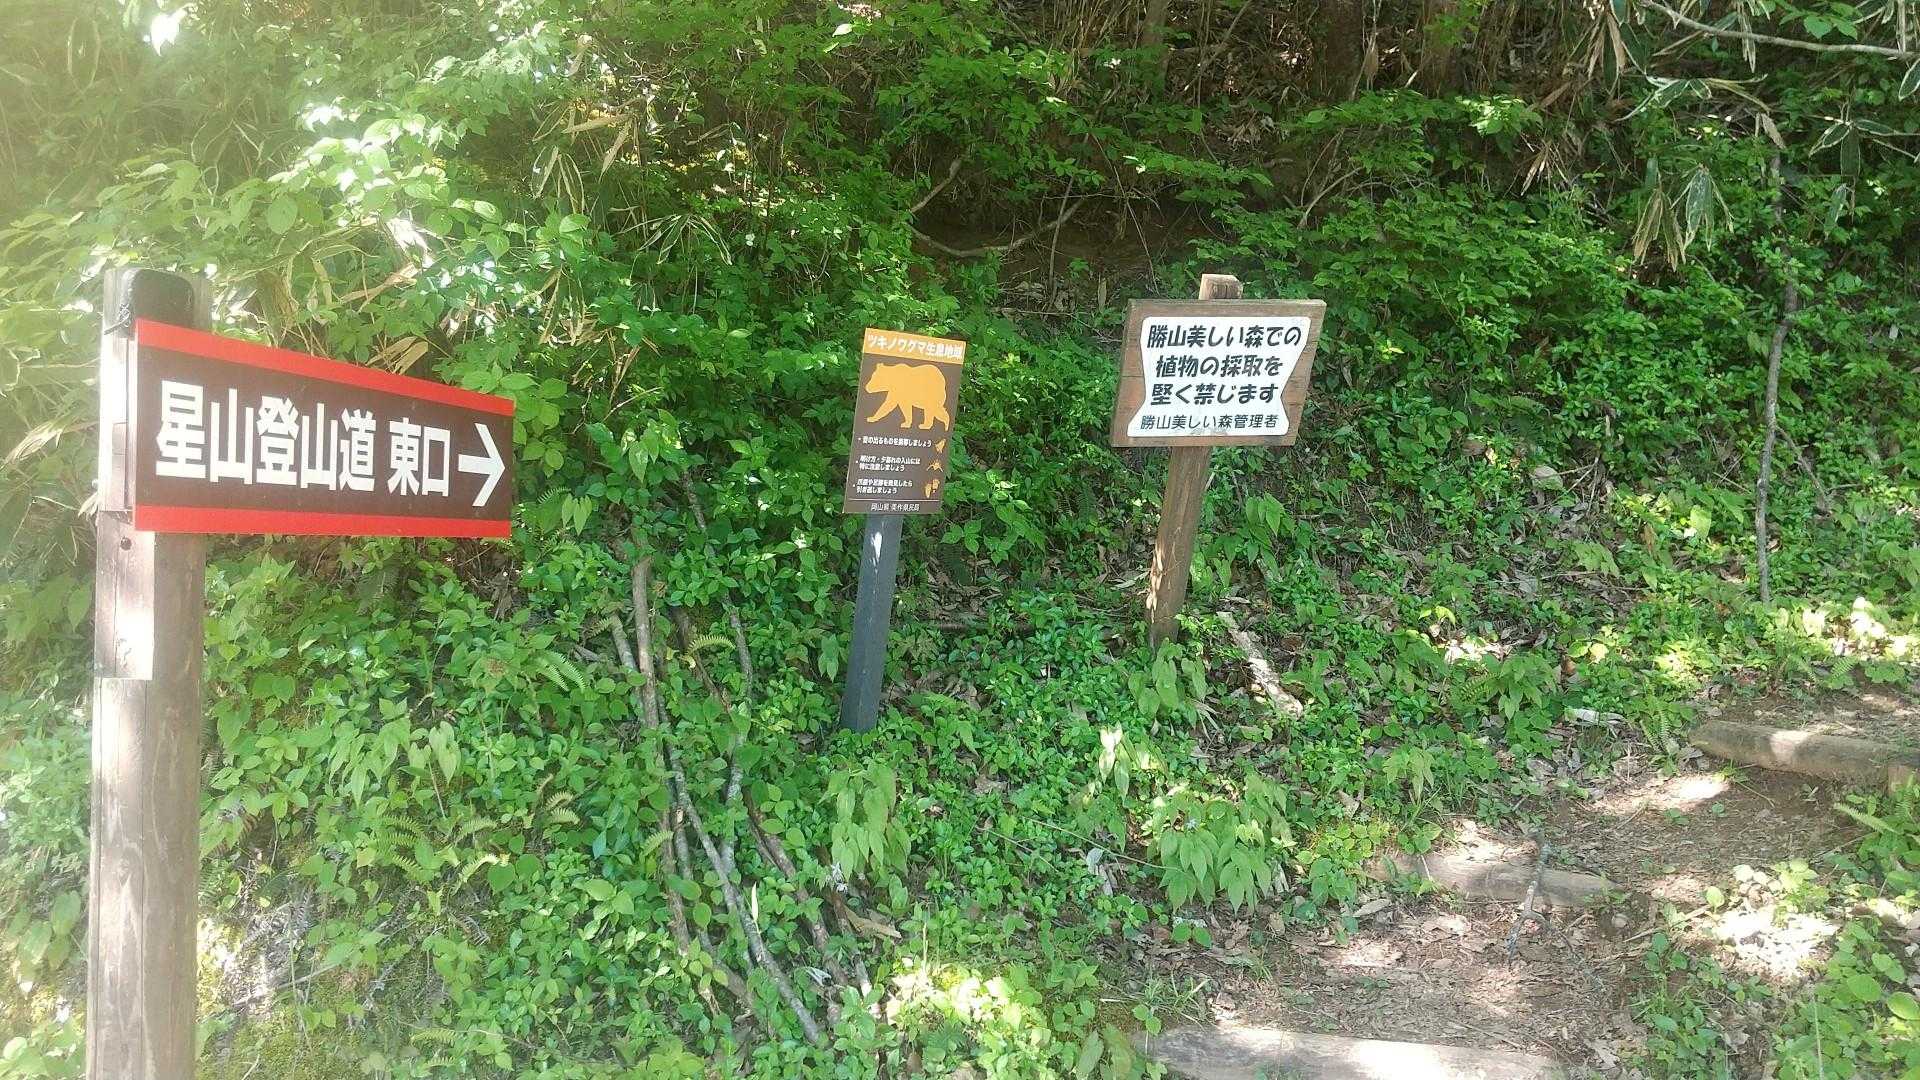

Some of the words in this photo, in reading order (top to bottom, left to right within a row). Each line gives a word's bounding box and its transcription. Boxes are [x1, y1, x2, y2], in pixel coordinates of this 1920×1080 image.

[867, 334, 963, 359] ツキノワグマ生息地域
[1147, 324, 1302, 348] 勝山美しい森での
[1156, 354, 1283, 378] 植物の採取を
[1151, 383, 1279, 406] 堅く禁じます
[1140, 414, 1278, 429] 勝山美しい森管理者
[155, 380, 376, 492] 星山登山道
[387, 417, 451, 497] 東口
